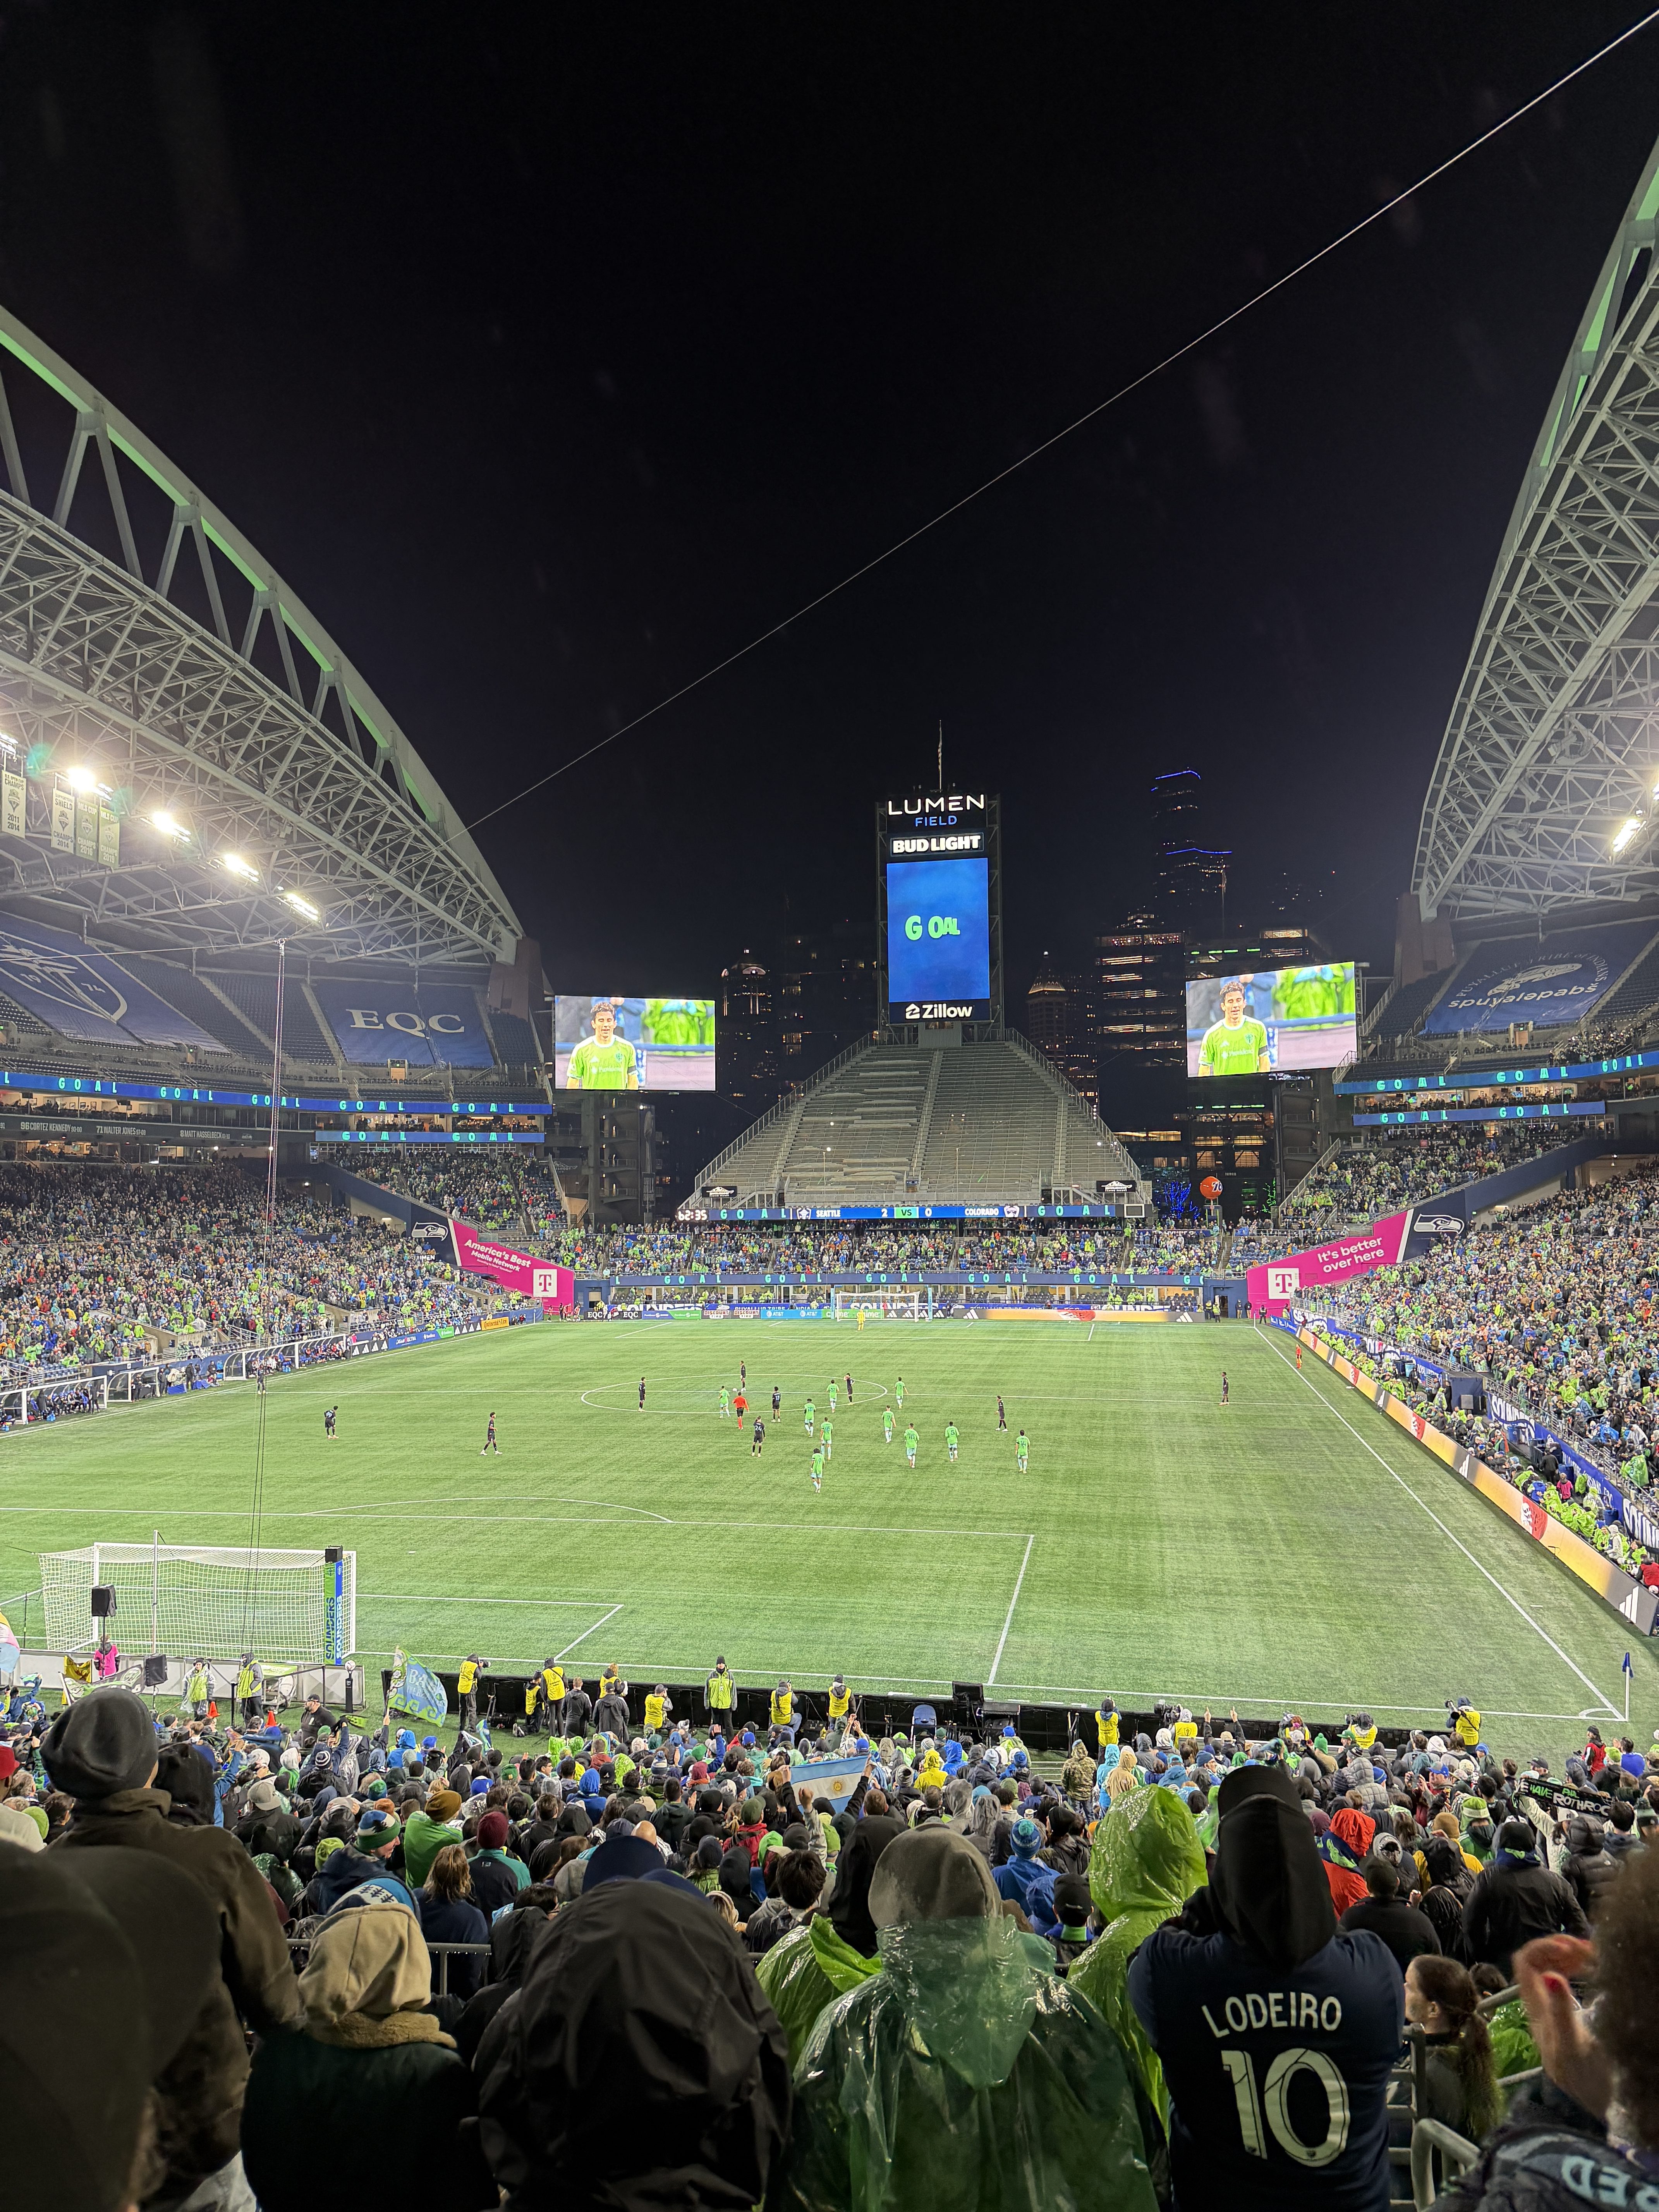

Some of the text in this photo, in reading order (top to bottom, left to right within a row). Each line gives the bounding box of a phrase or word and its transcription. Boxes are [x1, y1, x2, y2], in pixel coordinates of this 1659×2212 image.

[5, 778, 24, 790] CHAMPS
[55, 798, 73, 811] SHIELD
[78, 802, 97, 815] MLS CUP
[888, 794, 984, 815] LUMEN
[8, 813, 19, 824] 2011
[100, 811, 110, 820] MLS
[915, 816, 957, 827] FIELD
[7, 821, 20, 831] 2014
[53, 831, 74, 843] CHAMPS
[57, 839, 69, 848] 2014
[77, 837, 96, 849] CHAMPS
[81, 845, 93, 856] 2016
[893, 835, 981, 853] BUD LIGHT
[100, 845, 118, 857] CHAMPS
[103, 852, 115, 863] 2019
[922, 1004, 973, 1019] Zillow
[346, 1009, 465, 1039] EQC
[1376, 1053, 1644, 1091] GOAL GOAL GOAL
[58, 1077, 117, 1094] GOAL
[160, 1086, 213, 1101] GOAL
[339, 1101, 405, 1111] GOAL
[452, 1103, 515, 1113] GOAL
[1380, 1103, 1570, 1124] GOAL GOAL
[21, 1121, 30, 1130] 96
[30, 1123, 48, 1131] CORTEZ
[49, 1124, 71, 1132] KENNEDY
[103, 1126, 121, 1134] WALTER
[122, 1127, 136, 1135] JONES
[196, 1131, 222, 1139] HASSELBECK
[342, 1131, 514, 1142] GOAL GOAL
[1211, 1182, 1223, 1193] 76
[678, 1209, 707, 1221] 62:35
[720, 1209, 786, 1220] GOAL
[816, 1209, 841, 1218] SEATTLE
[881, 1208, 888, 1218] 2
[925, 1208, 932, 1217] 0
[1038, 1205, 1110, 1217] GOAL
[464, 1239, 531, 1267] America's Best
[1317, 1238, 1382, 1264] It's better
[471, 1250, 493, 1262] Mobile
[493, 1257, 520, 1272] Network
[1323, 1248, 1385, 1273] over here
[664, 1275, 721, 1285] GOAL
[764, 1274, 822, 1284] GOAL
[866, 1273, 923, 1283] GOAL
[968, 1273, 1027, 1283] GOAL
[1073, 1274, 1135, 1284] GOAL
[326, 1597, 335, 1660] SOUNDERS
[1530, 1784, 1554, 1799] HAVE
[1201, 1992, 1342, 2038] LODEIRO
[1221, 2048, 1351, 2167] 10
